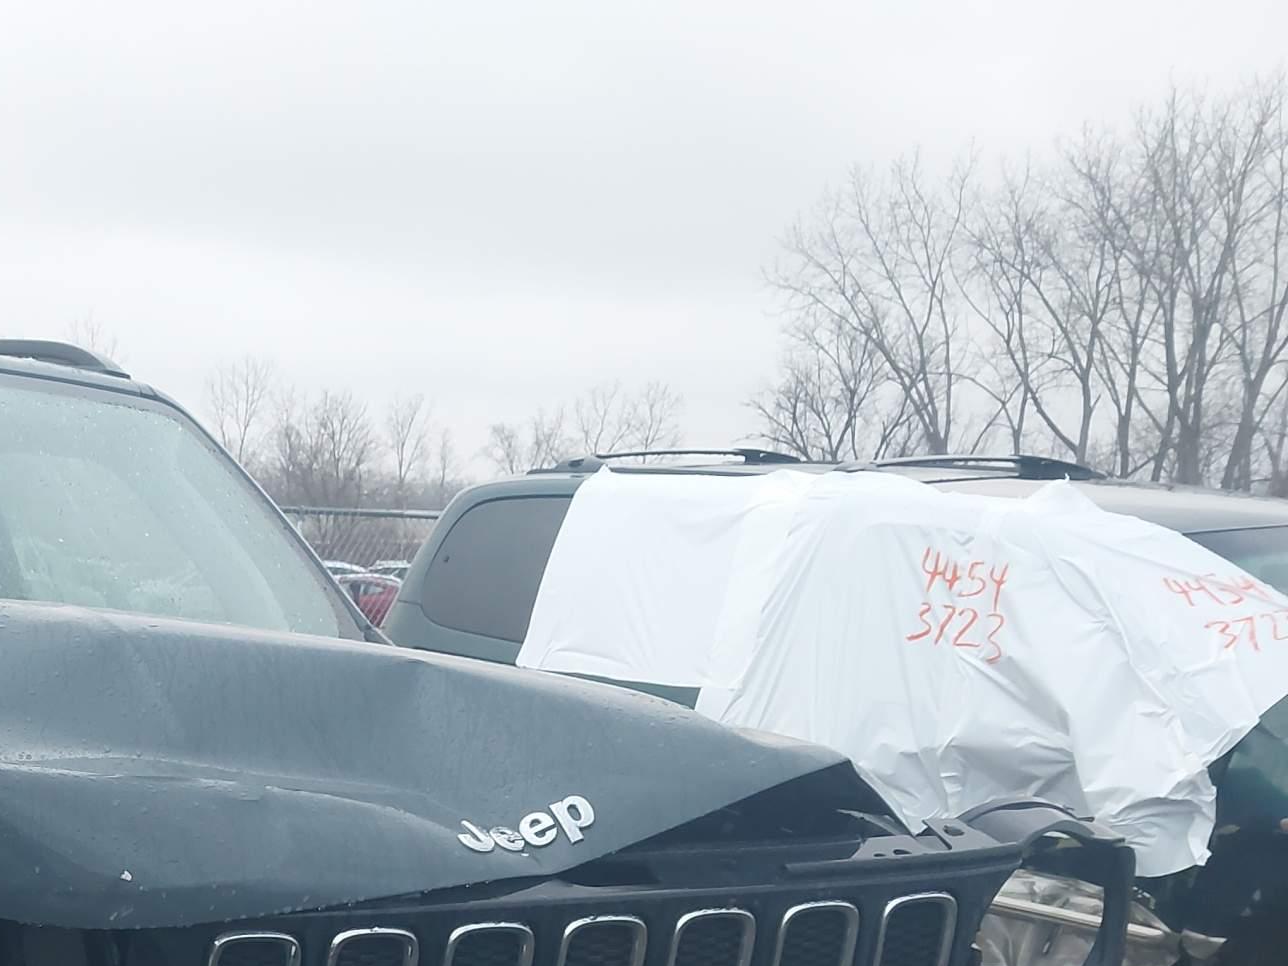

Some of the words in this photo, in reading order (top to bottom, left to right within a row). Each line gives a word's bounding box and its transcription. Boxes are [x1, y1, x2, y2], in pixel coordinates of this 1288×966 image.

[922, 546, 1009, 612] 4454
[906, 602, 1005, 664] 3723
[457, 795, 596, 853] Jeep
